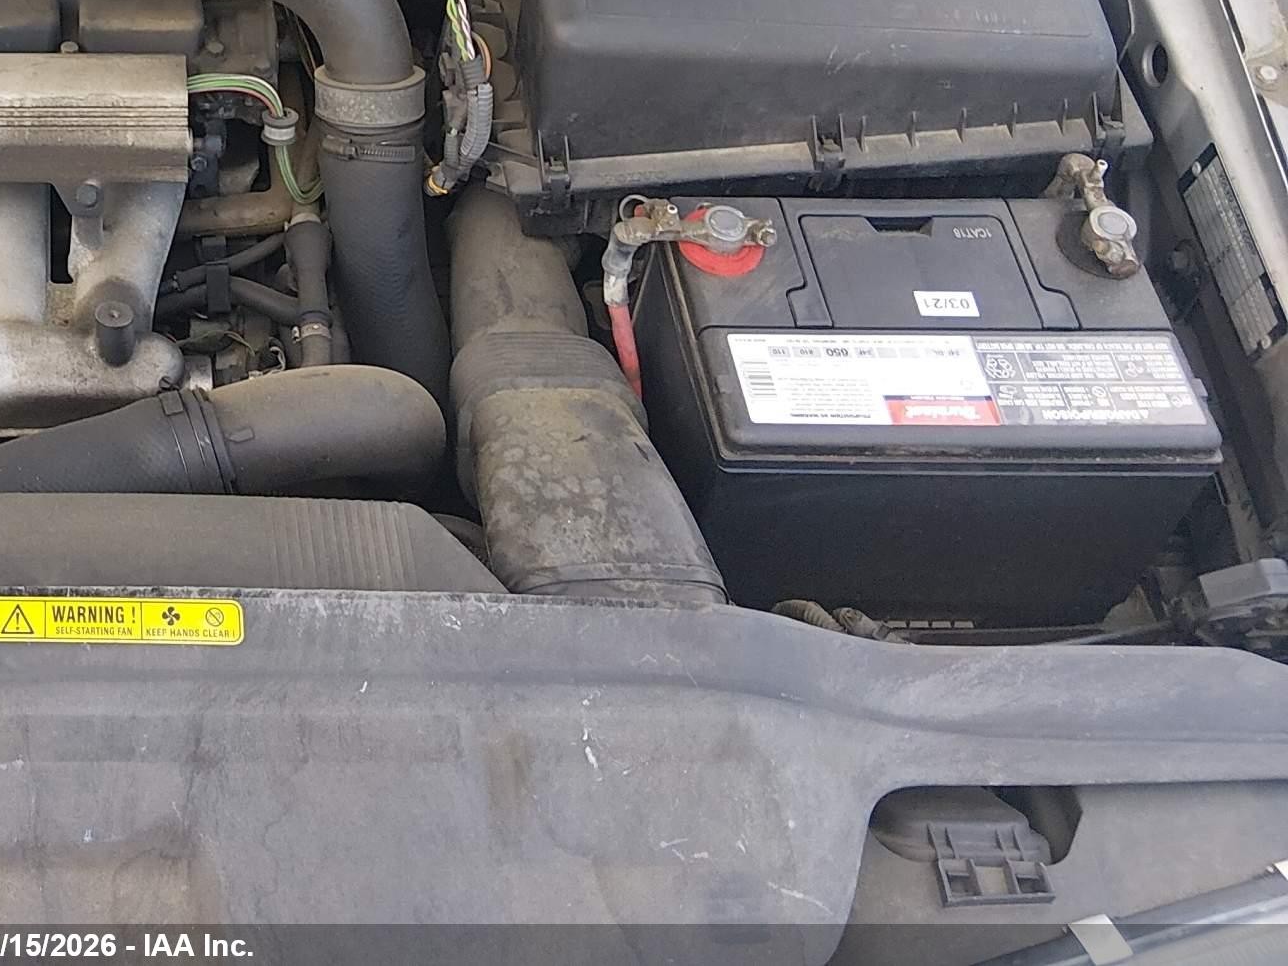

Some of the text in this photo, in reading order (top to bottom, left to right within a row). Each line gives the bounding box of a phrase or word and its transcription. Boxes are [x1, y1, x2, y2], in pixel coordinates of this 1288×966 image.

[826, 348, 849, 357] 650
[52, 605, 125, 623] WARNING
[55, 626, 133, 636] SELF-STARTING FAN
[145, 628, 168, 637] KEEP
[170, 628, 200, 637] HANDS
[202, 628, 230, 638] CLEAR
